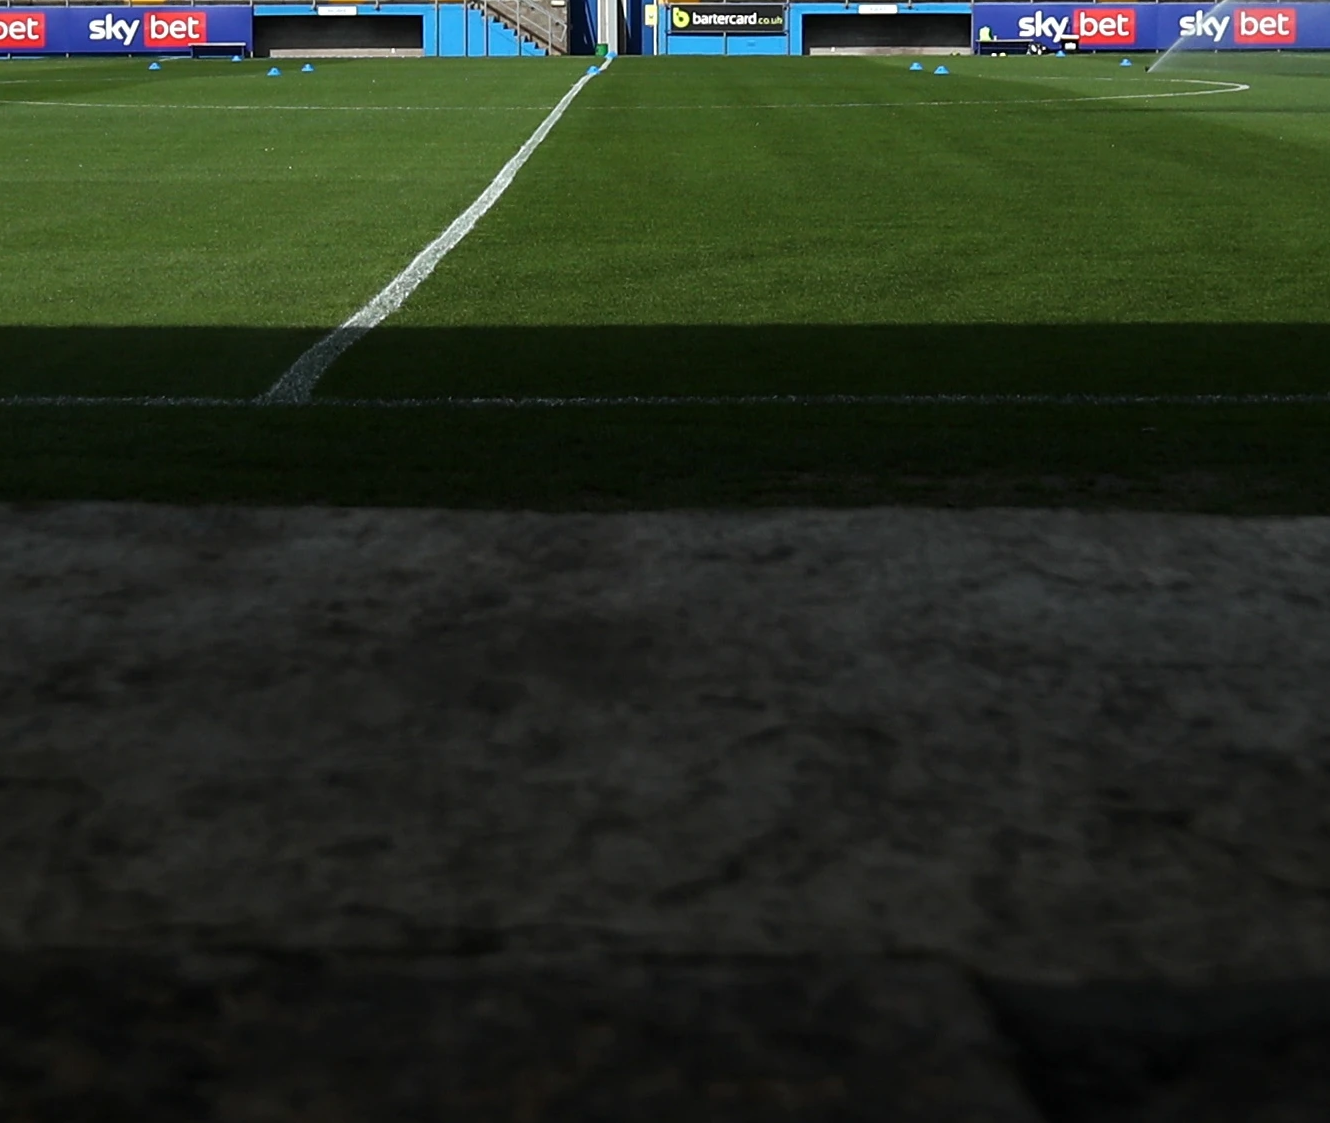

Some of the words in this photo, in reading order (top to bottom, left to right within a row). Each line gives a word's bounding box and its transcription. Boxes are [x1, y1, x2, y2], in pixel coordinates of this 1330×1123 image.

[88, 13, 141, 46] sky
[150, 14, 200, 40] bet
[1018, 10, 1069, 43] sky
[1079, 11, 1130, 37] bet
[1179, 9, 1231, 43] sky
[1240, 11, 1290, 36] bet
